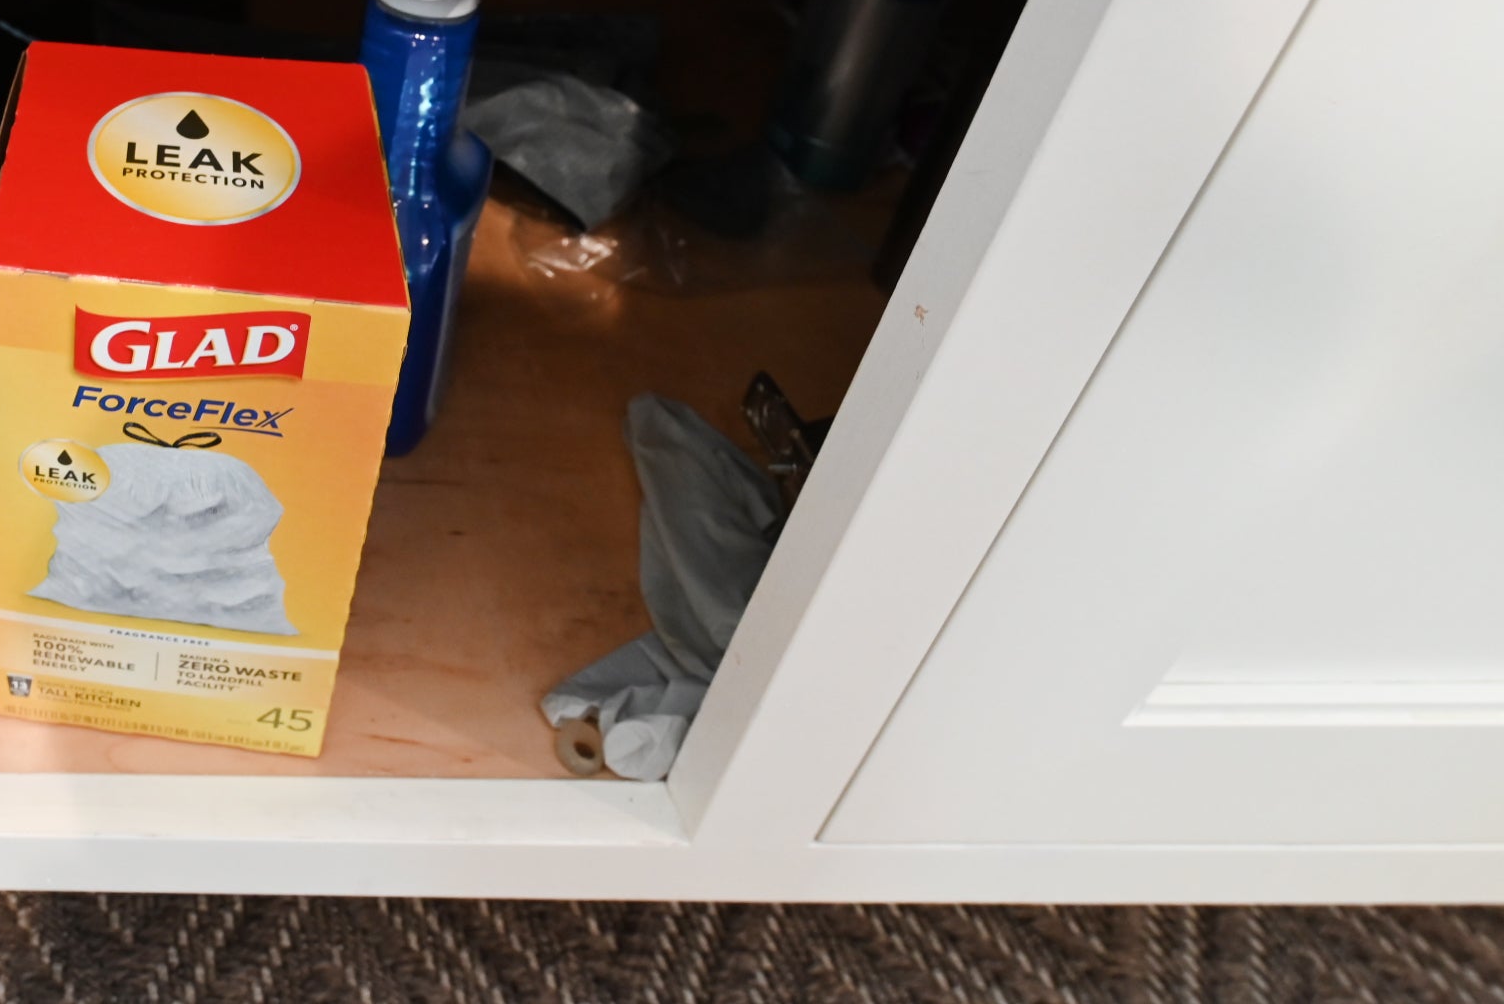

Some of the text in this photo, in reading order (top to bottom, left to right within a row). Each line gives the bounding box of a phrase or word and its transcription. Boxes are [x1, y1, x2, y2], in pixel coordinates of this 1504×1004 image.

[125, 141, 265, 176] LEAK
[121, 167, 265, 190] PROTECTION
[71, 384, 294, 430] ForceFlex
[32, 476, 98, 491] PROTECTION
[34, 464, 97, 485] LEAK
[33, 639, 84, 655] 100%
[109, 628, 211, 647] FRAGRANCE FREE
[32, 649, 136, 672] RENEWABLE
[32, 658, 88, 672] ENERGY
[178, 659, 303, 683] ZERO WASTE
[176, 678, 235, 692] FACILITY
[177, 670, 264, 687] TO LANDFILL
[39, 686, 71, 699] TALL
[74, 692, 142, 709] KITCHEN
[256, 707, 314, 732] 45
